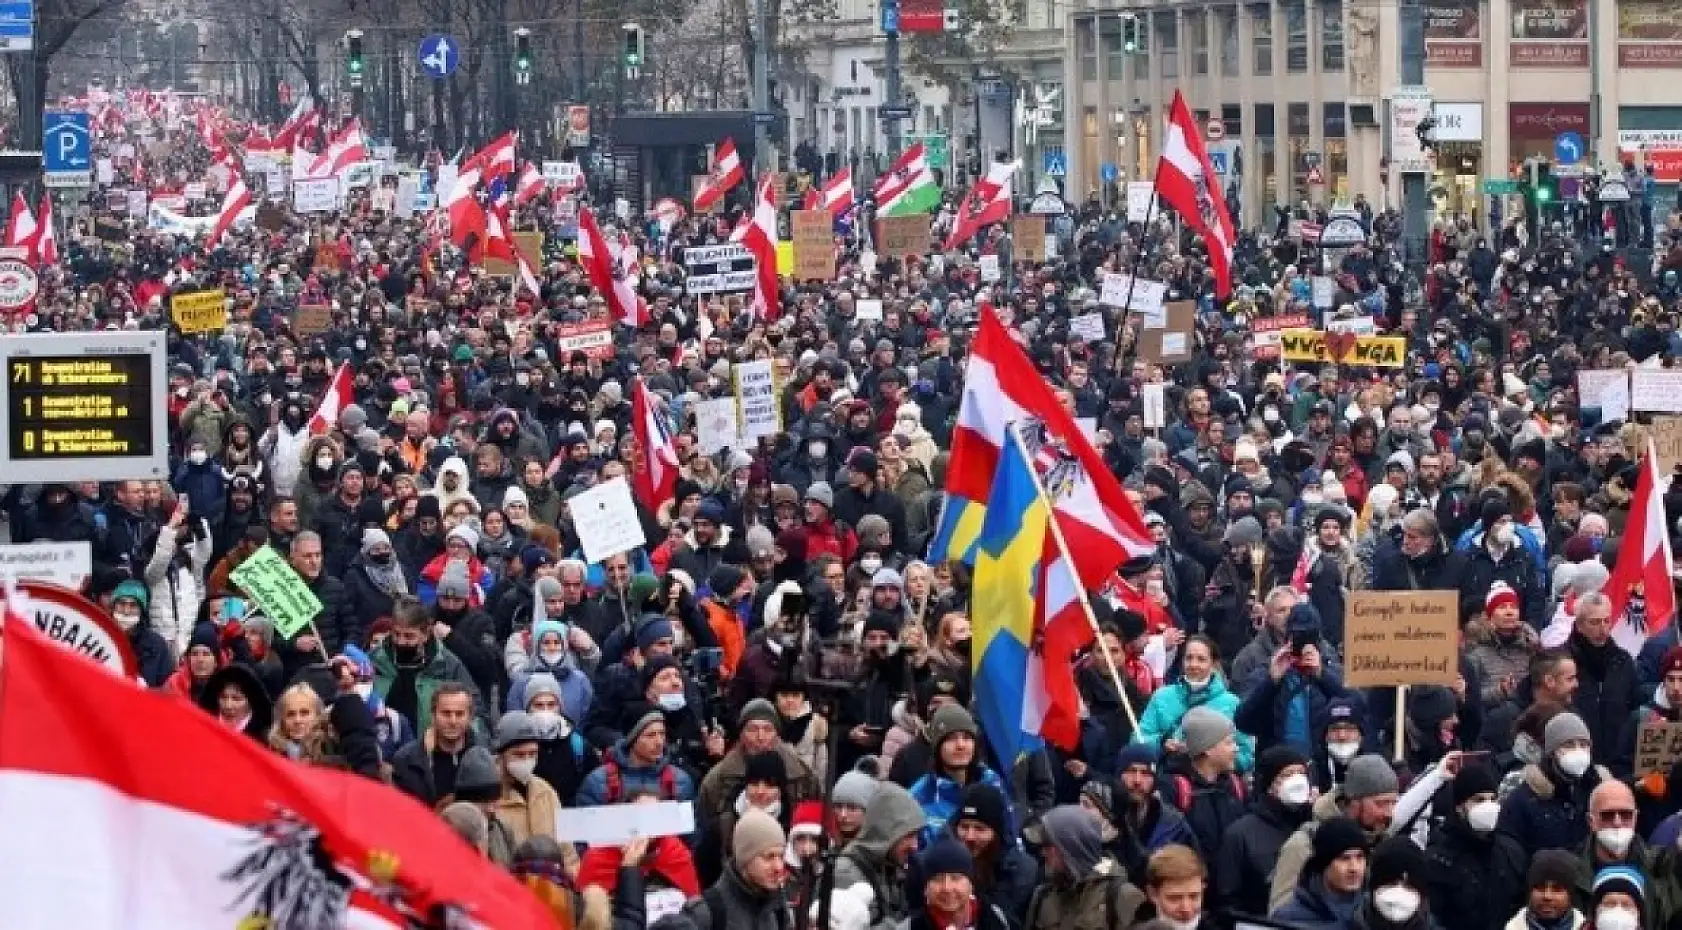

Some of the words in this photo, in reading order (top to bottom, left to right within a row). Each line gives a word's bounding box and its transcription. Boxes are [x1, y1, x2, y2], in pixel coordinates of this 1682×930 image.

[59, 131, 78, 161] P
[13, 362, 32, 383] 71
[23, 396, 32, 417] 1
[1411, 600, 1446, 614] haben
[1353, 632, 1385, 641] einen
